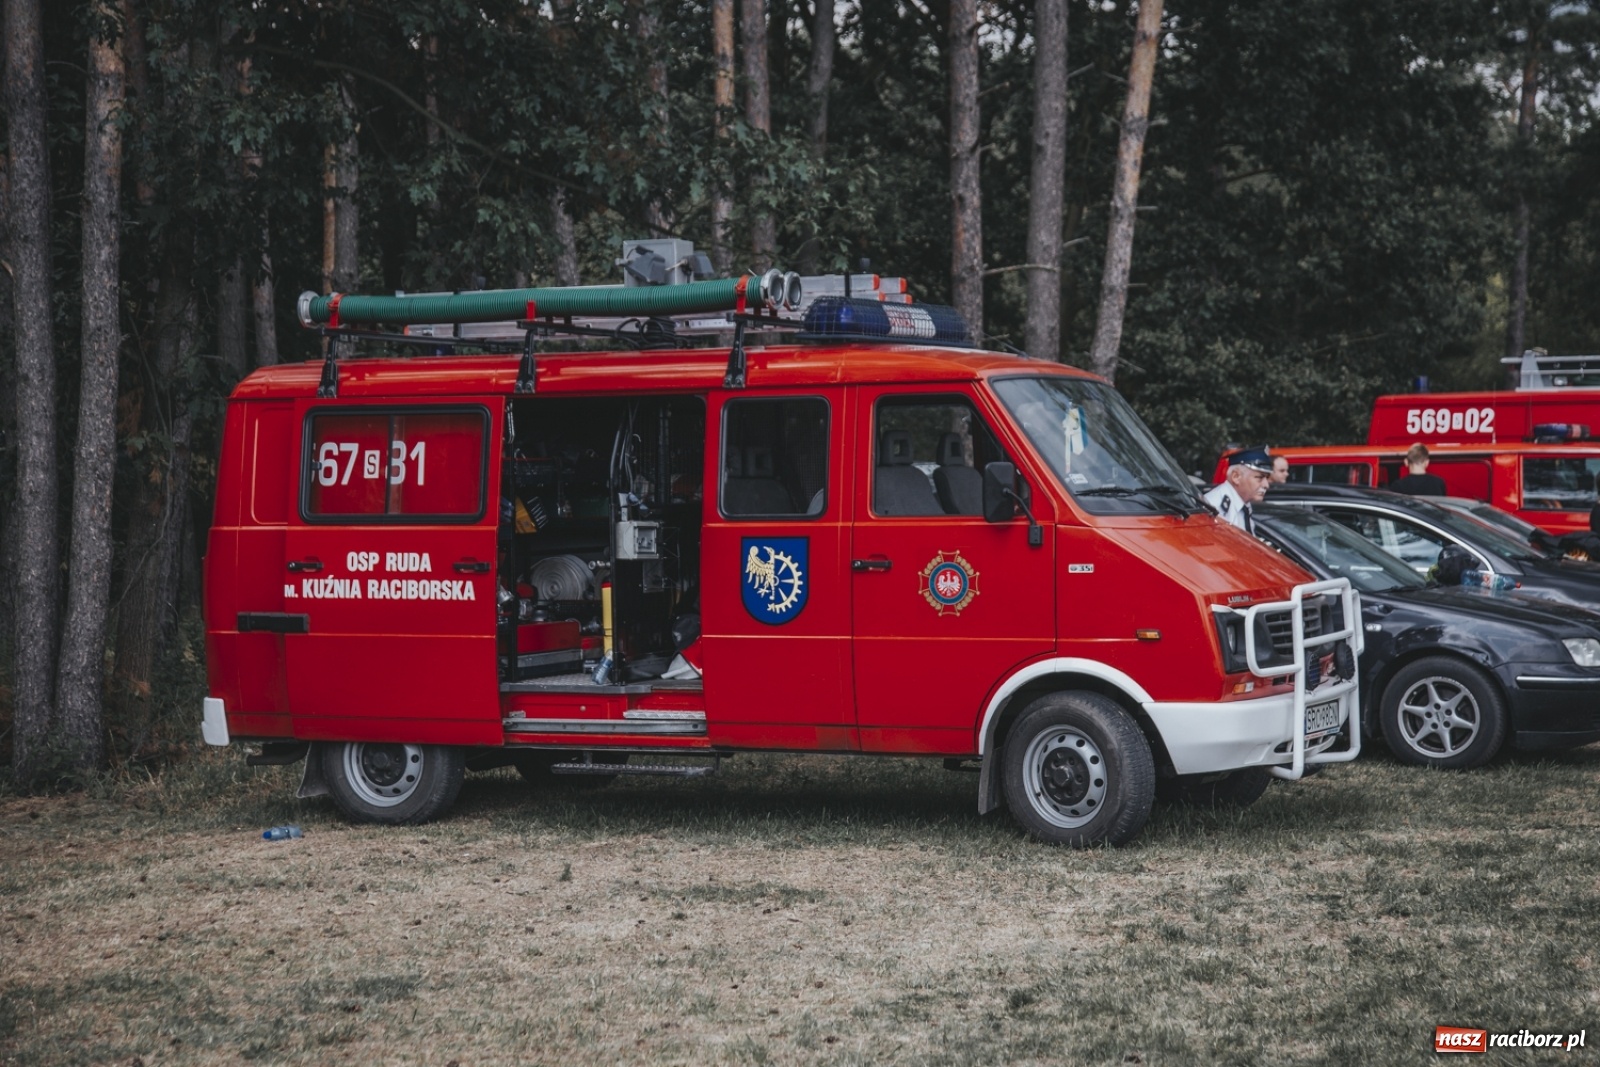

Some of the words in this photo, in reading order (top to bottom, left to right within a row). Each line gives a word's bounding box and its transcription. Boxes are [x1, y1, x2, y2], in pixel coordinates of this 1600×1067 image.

[1406, 408, 1451, 434] 569
[1464, 407, 1495, 433] 02
[311, 441, 359, 487] 67
[347, 552, 380, 572] OSP
[385, 553, 432, 572] RUDA
[302, 575, 362, 599] KUŹNIA
[367, 579, 476, 601] RACIBORSKA
